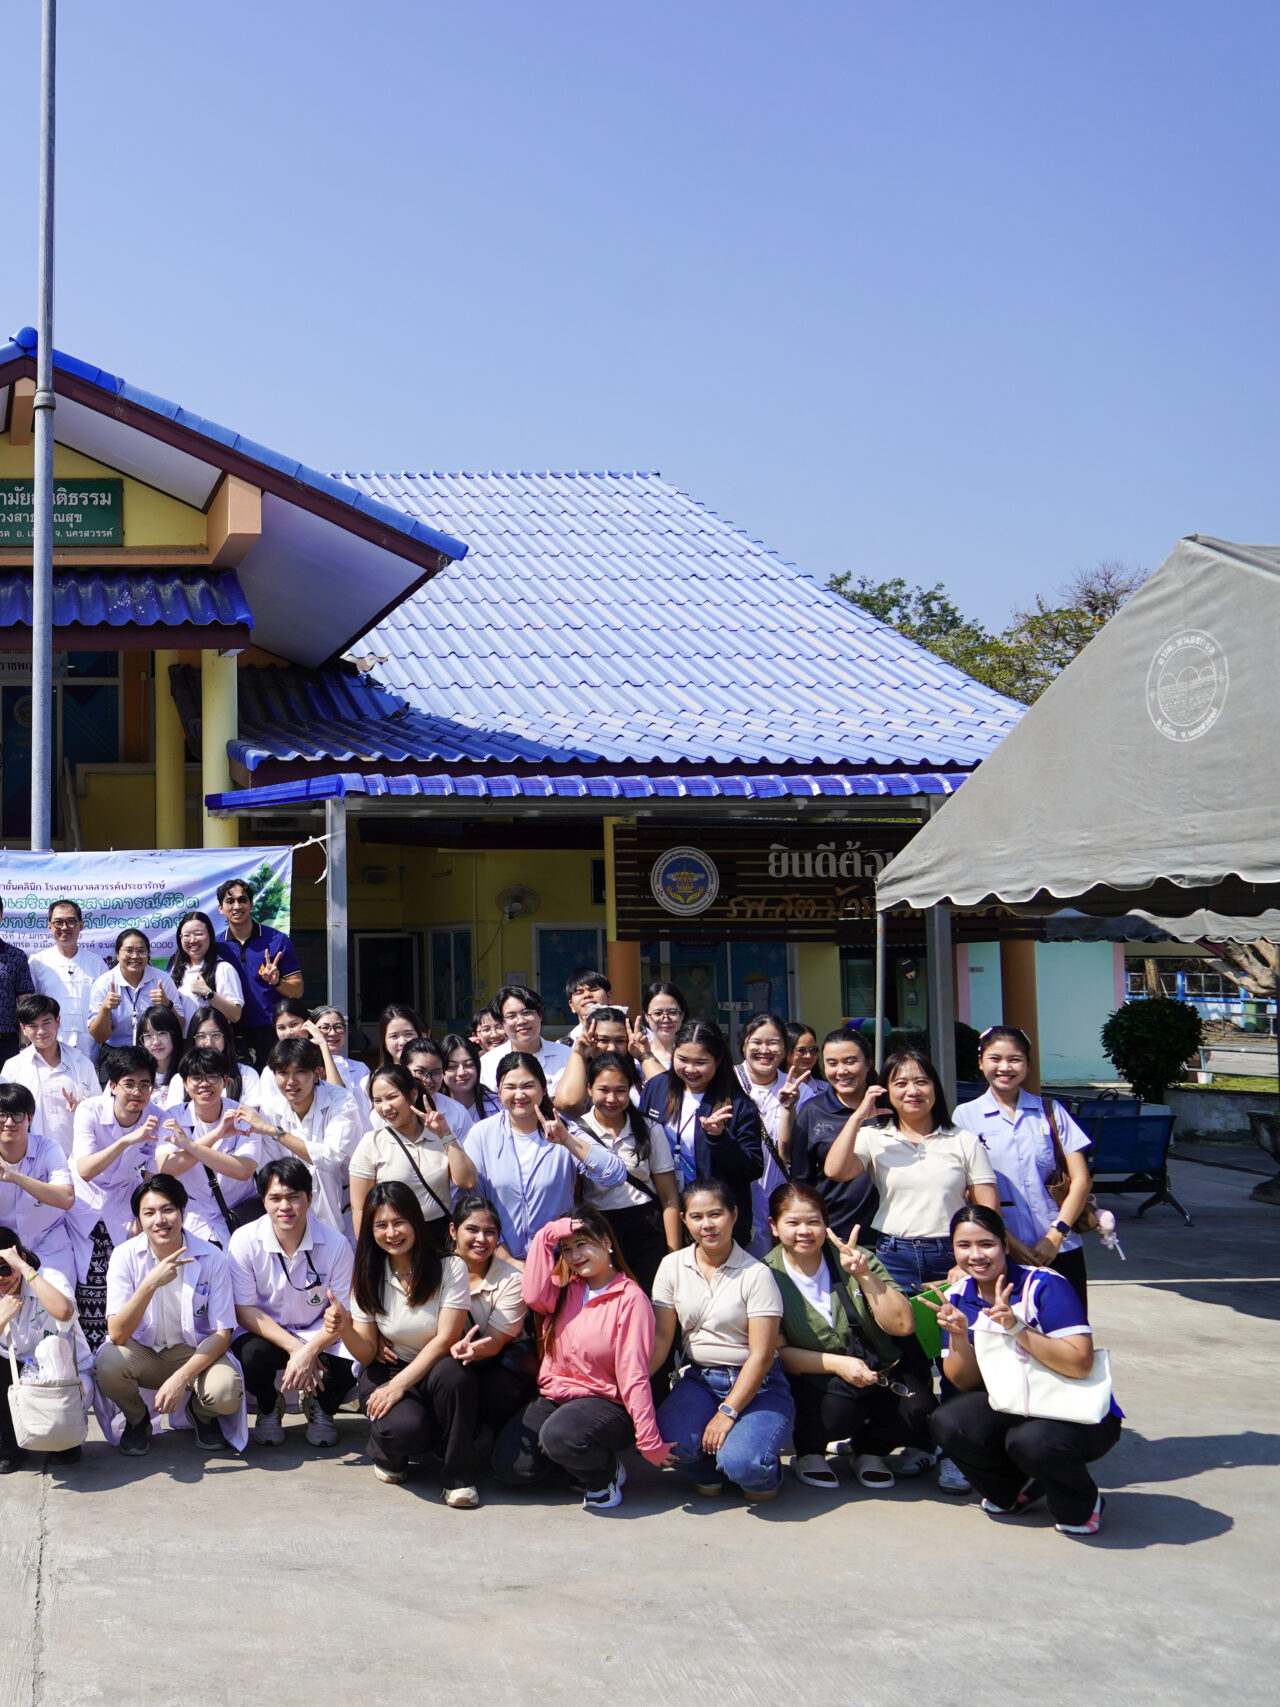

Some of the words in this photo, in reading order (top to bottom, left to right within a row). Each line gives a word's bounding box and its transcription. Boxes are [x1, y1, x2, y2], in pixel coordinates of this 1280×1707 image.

[66, 527, 114, 538] นครสวรรค์
[767, 840, 894, 878] ยินดีต้อ
[18, 932, 26, 940] 17
